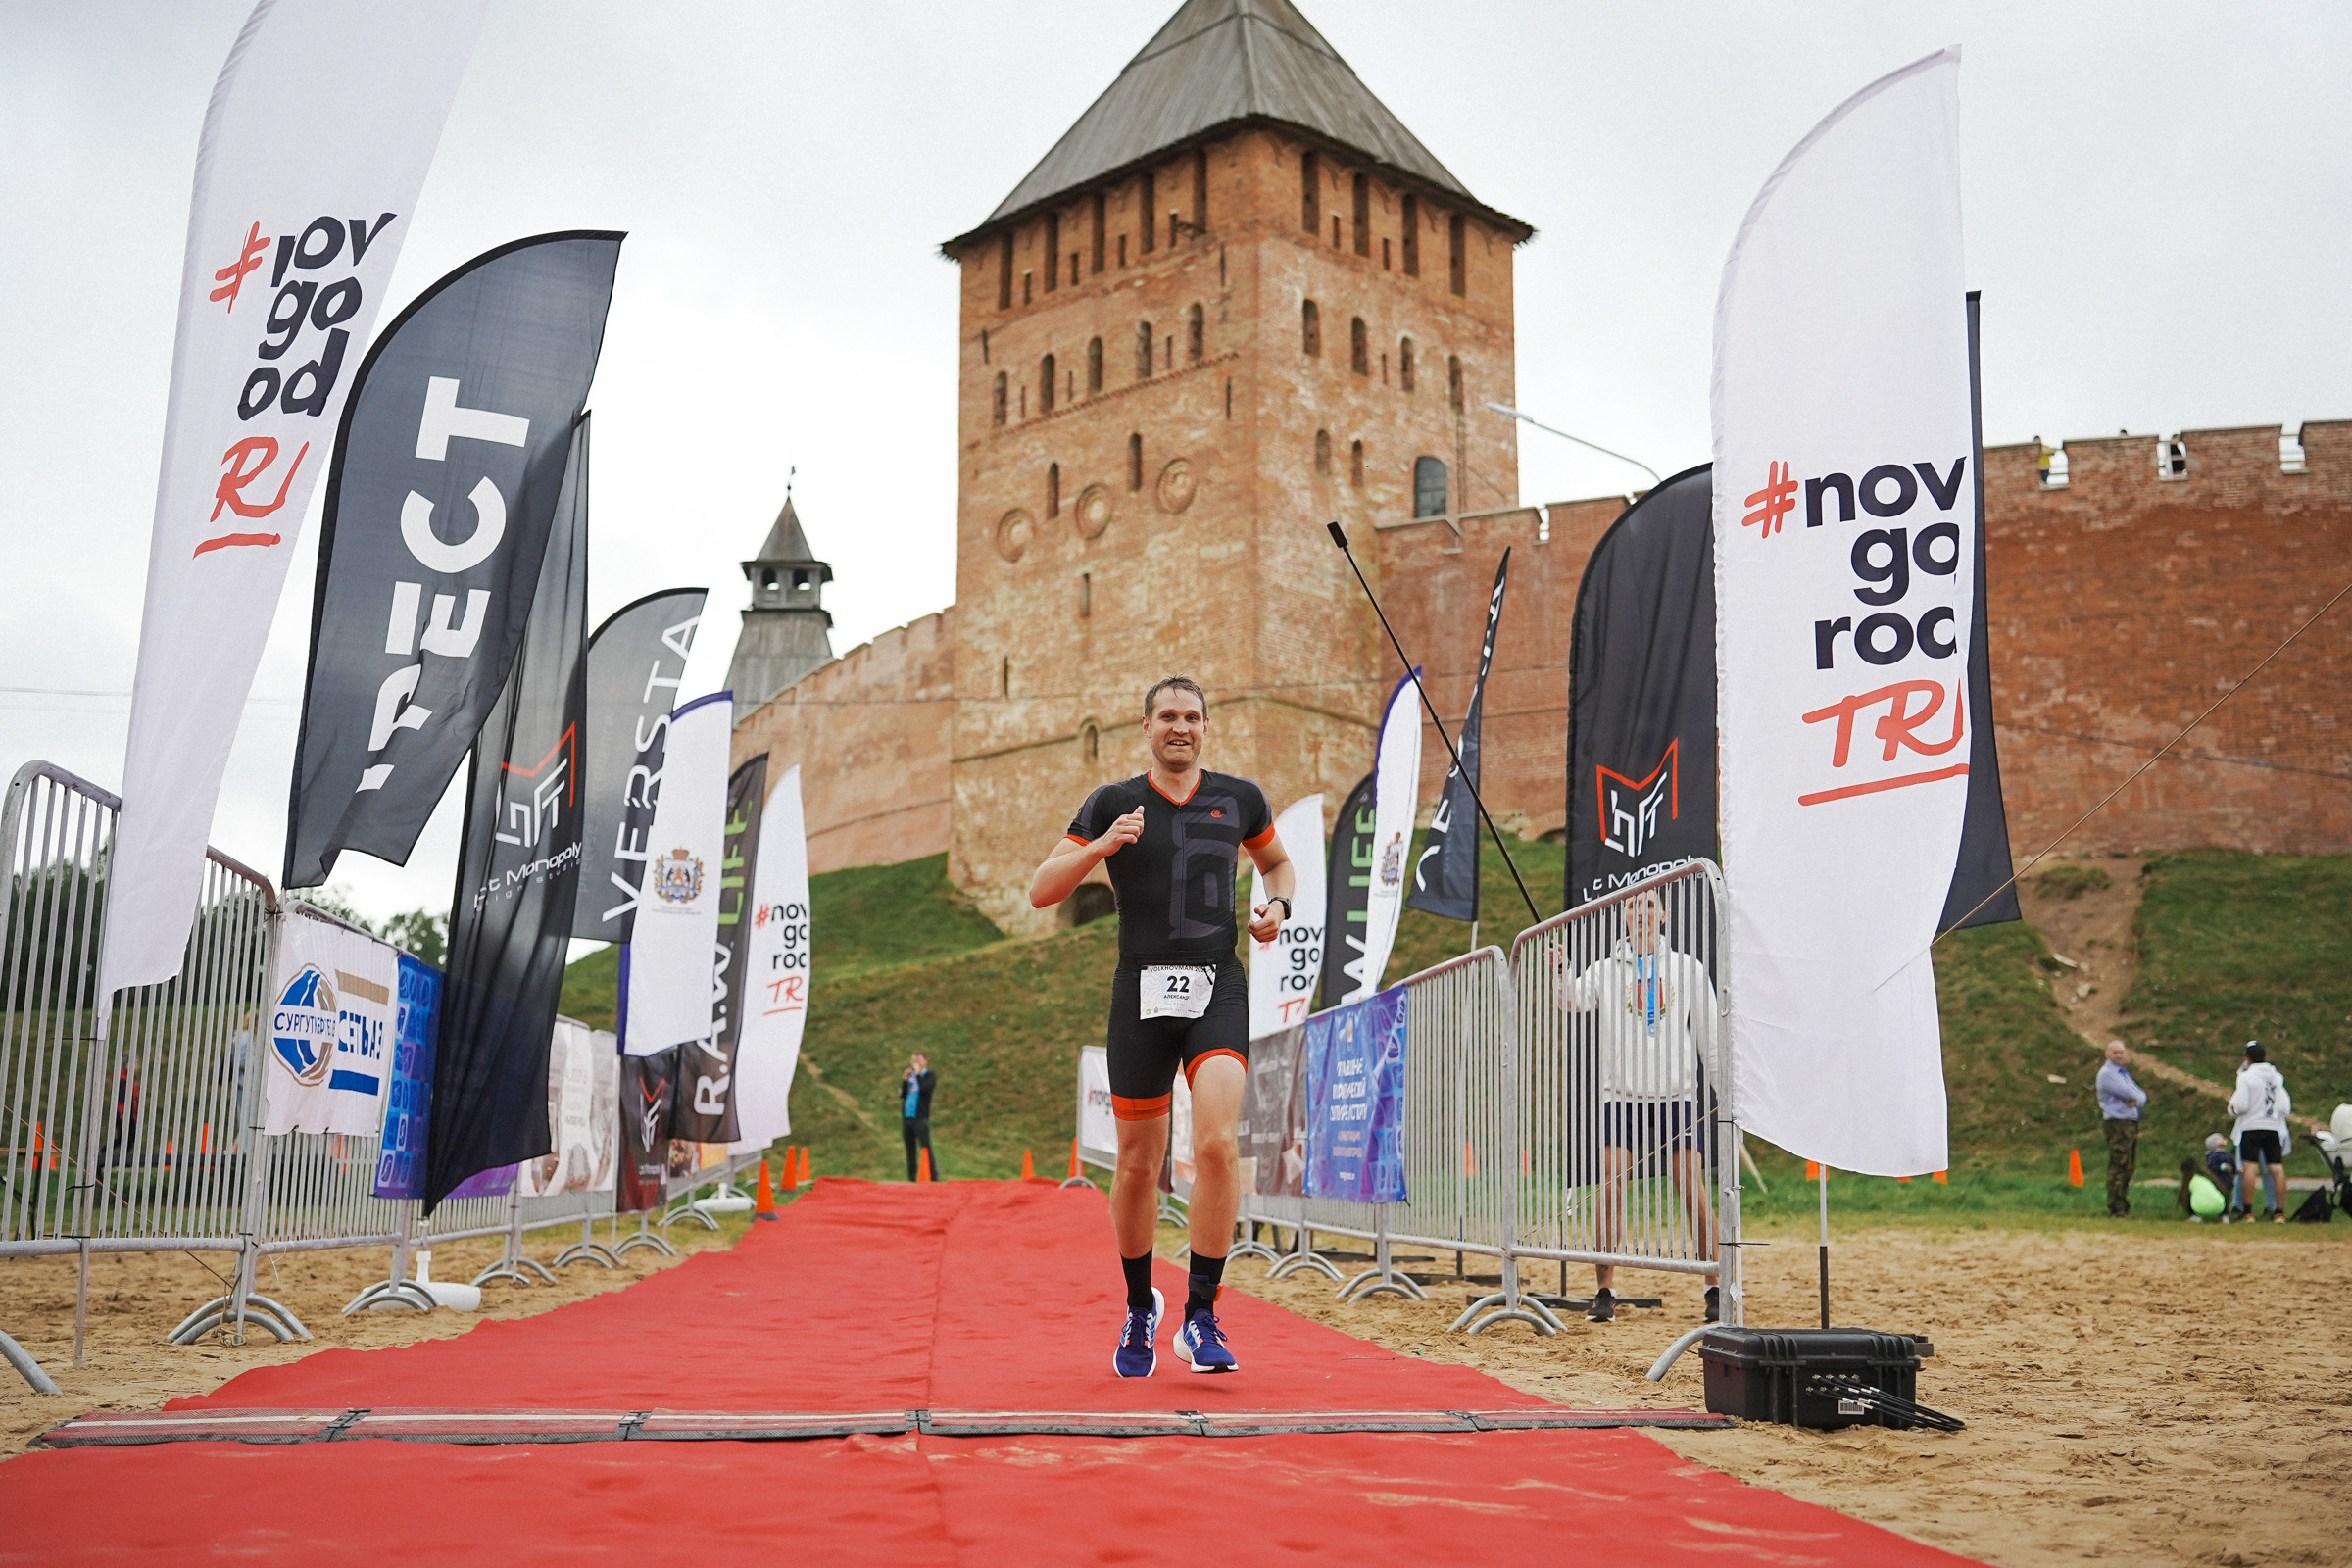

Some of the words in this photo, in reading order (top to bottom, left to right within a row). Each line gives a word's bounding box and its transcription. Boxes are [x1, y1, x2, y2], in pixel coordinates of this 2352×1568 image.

[258, 276, 363, 360] go
[237, 327, 350, 421] od
[1741, 456, 1968, 539] #nov
[1850, 521, 1960, 606] go
[506, 841, 582, 886] Monopoly
[767, 976, 804, 1004] TR
[1166, 975, 1190, 994] 22
[1291, 947, 1320, 971] go
